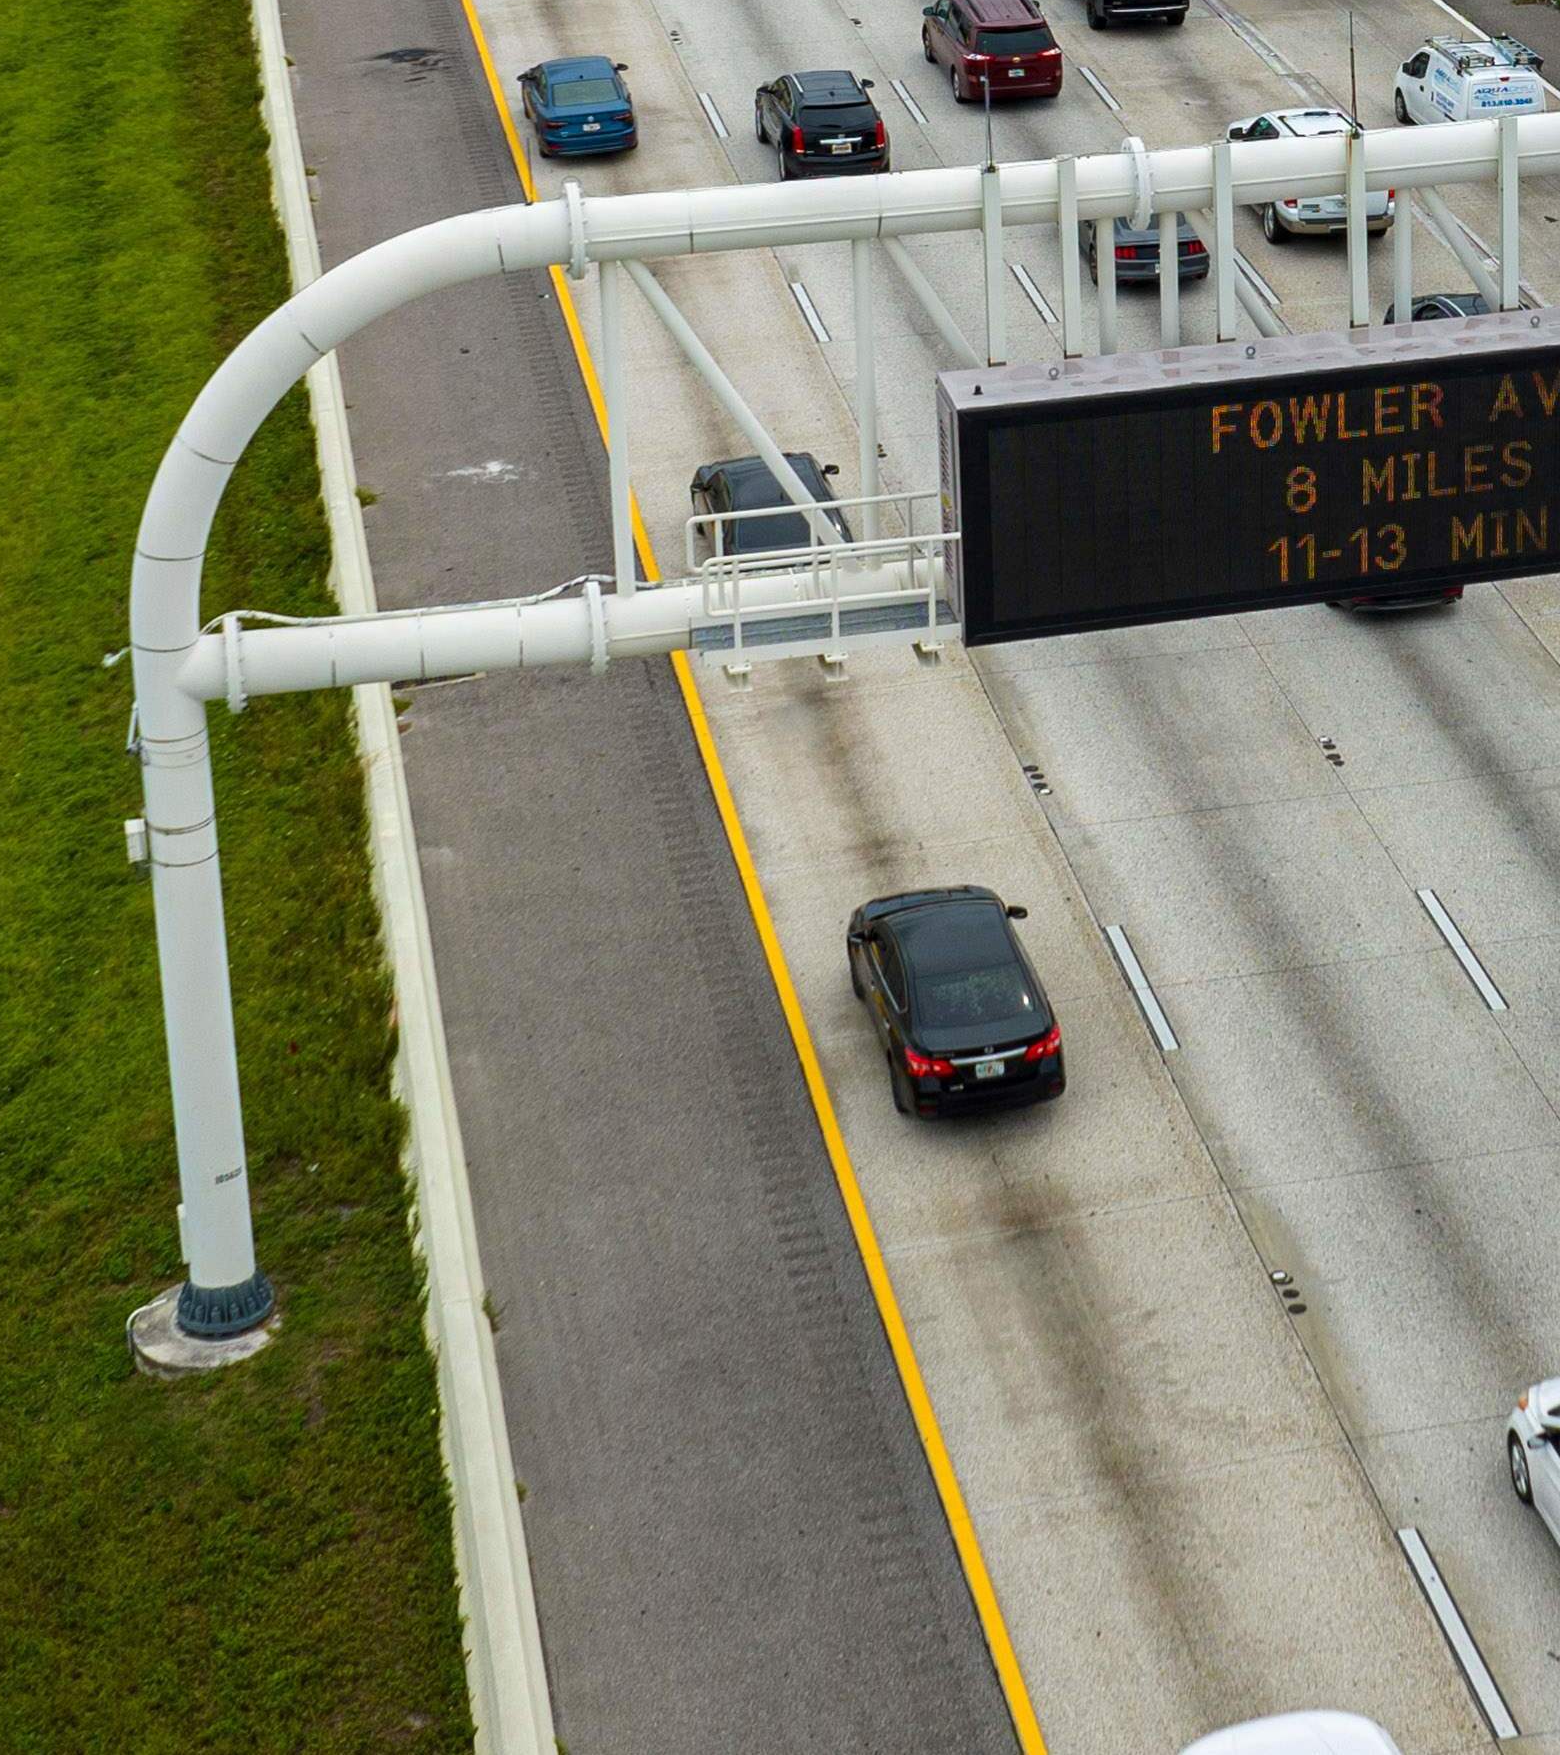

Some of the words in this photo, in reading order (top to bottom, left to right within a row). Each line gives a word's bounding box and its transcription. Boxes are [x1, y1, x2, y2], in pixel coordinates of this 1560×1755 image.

[1211, 382, 1445, 454] FOWLER
[1285, 465, 1318, 514] 8
[1360, 440, 1534, 506] MILES
[1267, 523, 1408, 583] 11-13
[1450, 506, 1549, 561] MIN
